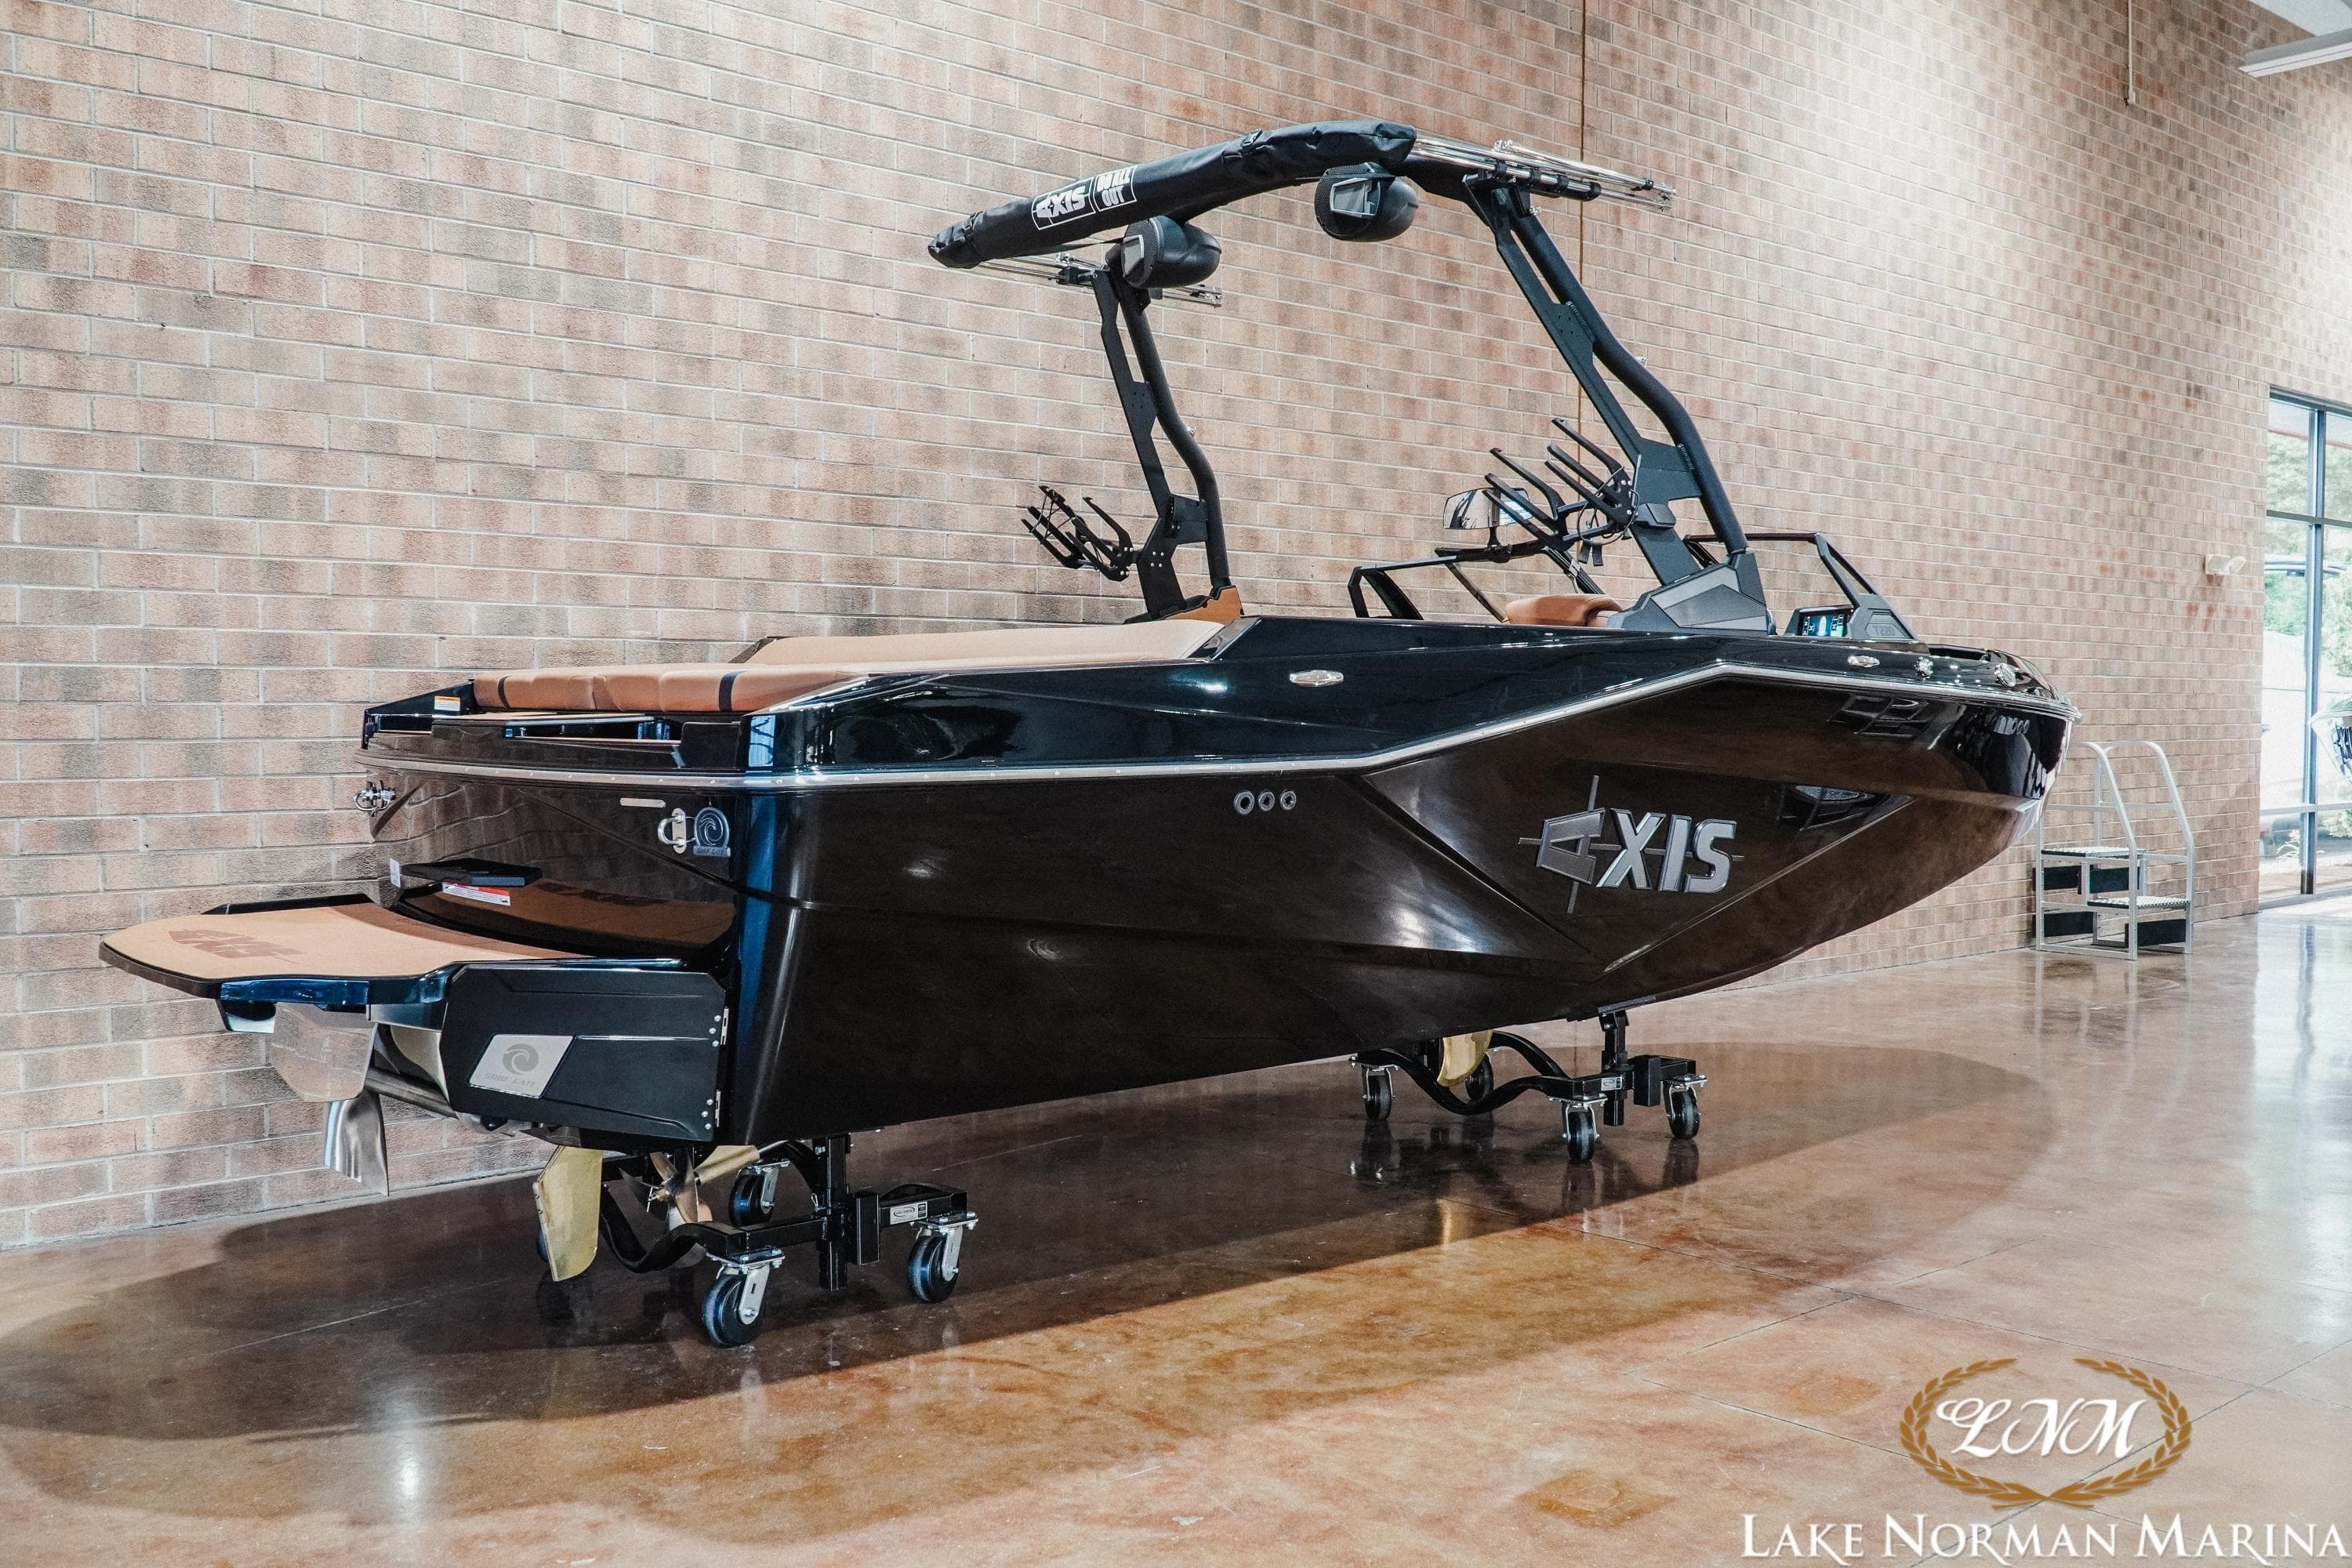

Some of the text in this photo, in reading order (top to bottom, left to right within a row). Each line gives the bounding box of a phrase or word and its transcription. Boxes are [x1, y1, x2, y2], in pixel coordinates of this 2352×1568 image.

[1036, 185, 1086, 218] AXIS
[1102, 185, 1125, 207] OUT
[1536, 808, 1737, 894] AXIS
